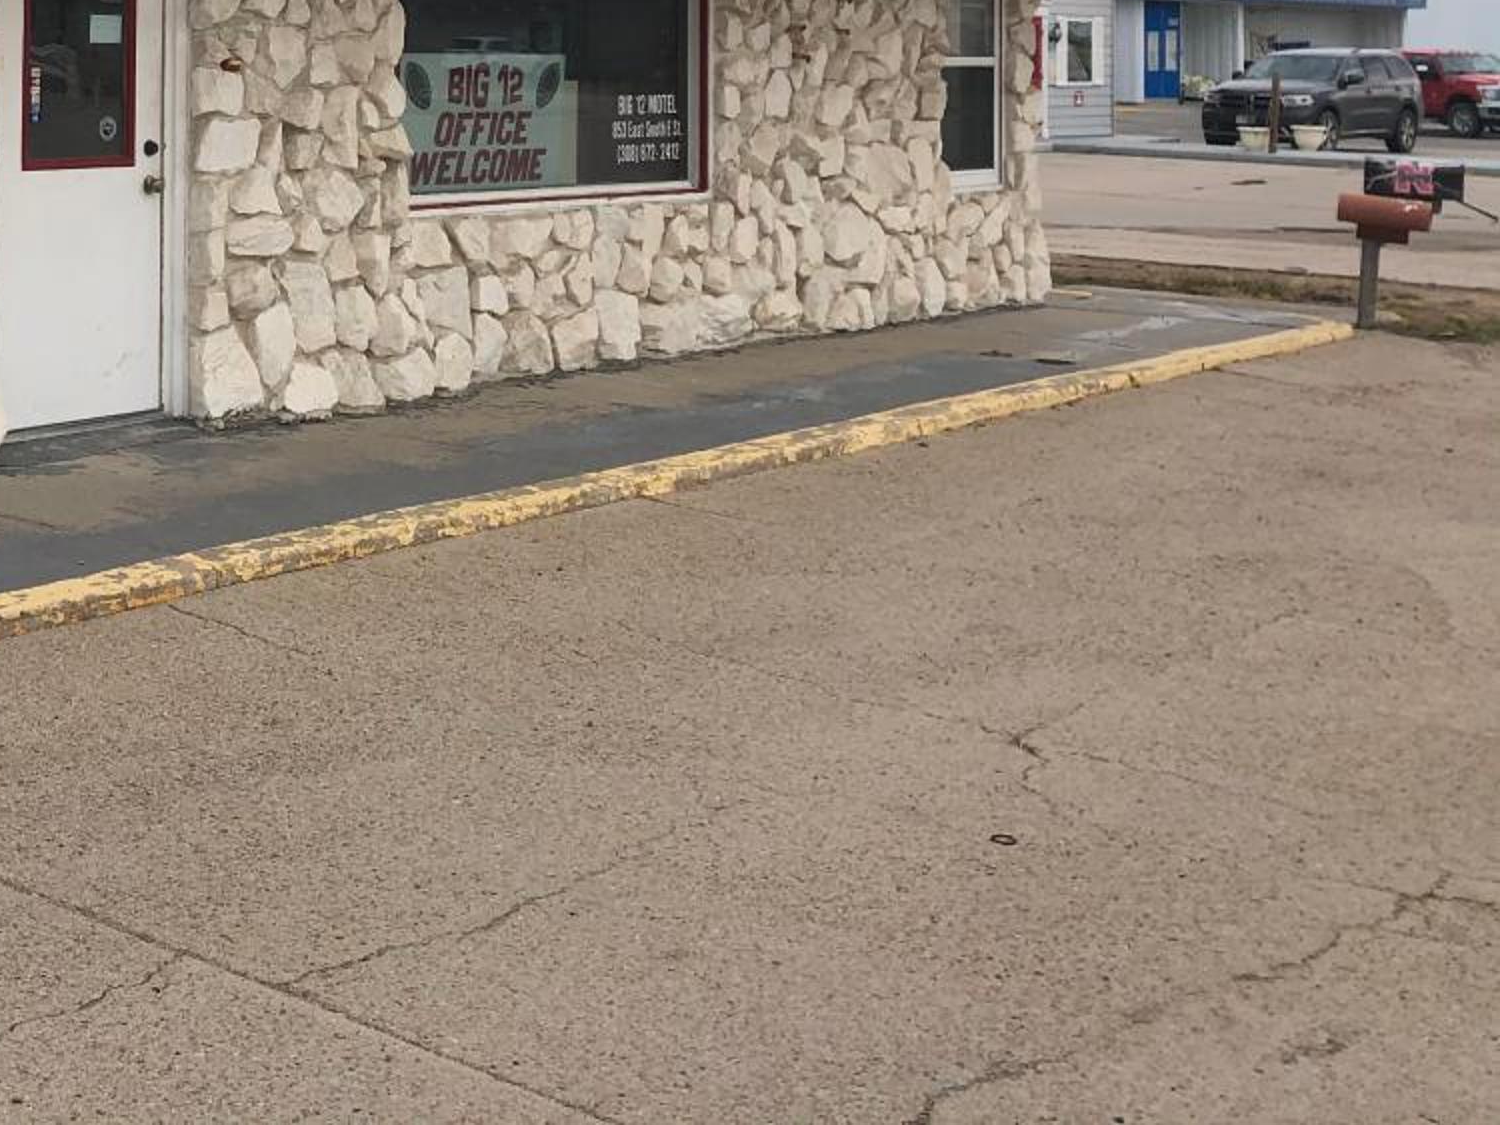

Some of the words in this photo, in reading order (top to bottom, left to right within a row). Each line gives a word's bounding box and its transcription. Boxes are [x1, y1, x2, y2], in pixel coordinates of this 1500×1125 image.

[448, 62, 490, 109] BIG
[498, 63, 524, 106] 12
[647, 93, 677, 115] MOTEL
[434, 110, 533, 148] OFFICE
[410, 148, 547, 187] WELCOME
